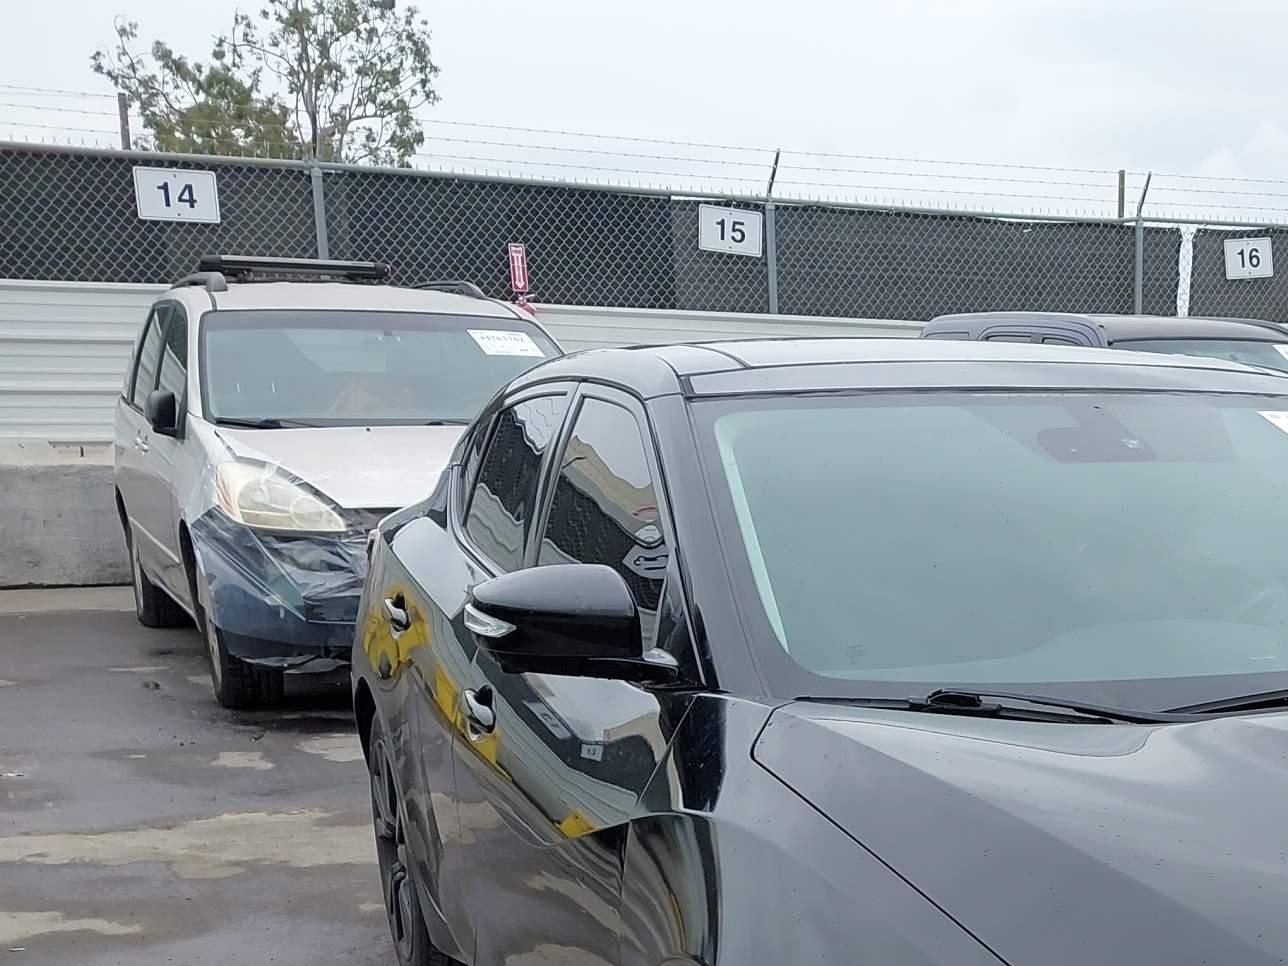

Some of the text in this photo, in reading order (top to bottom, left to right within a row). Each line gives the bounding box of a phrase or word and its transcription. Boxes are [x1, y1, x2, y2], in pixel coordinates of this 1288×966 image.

[156, 181, 198, 209] 14
[715, 218, 746, 244] 15
[1237, 247, 1261, 269] 16
